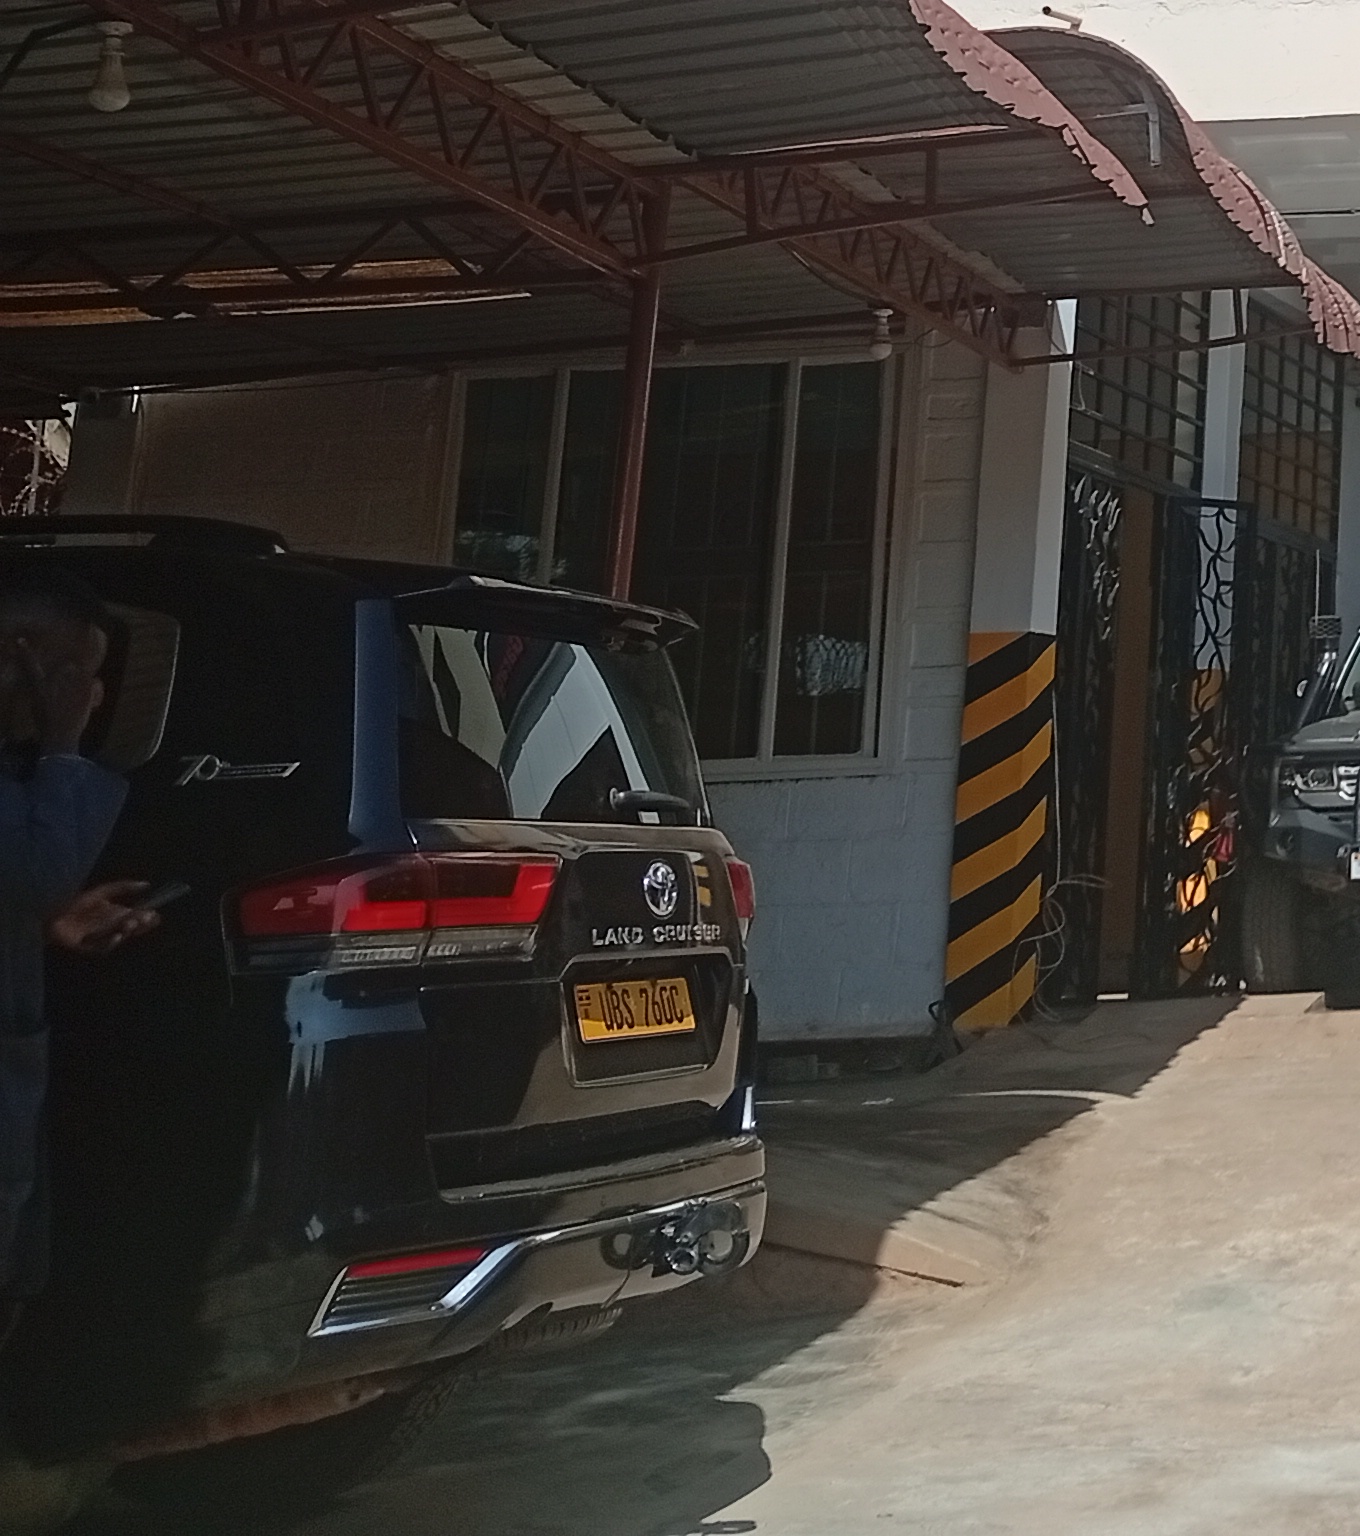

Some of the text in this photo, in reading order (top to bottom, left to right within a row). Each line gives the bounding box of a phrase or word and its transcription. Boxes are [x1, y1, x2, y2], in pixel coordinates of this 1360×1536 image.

[592, 924, 721, 946] LAND CRUISER
[599, 985, 684, 1031] UBS 760C
